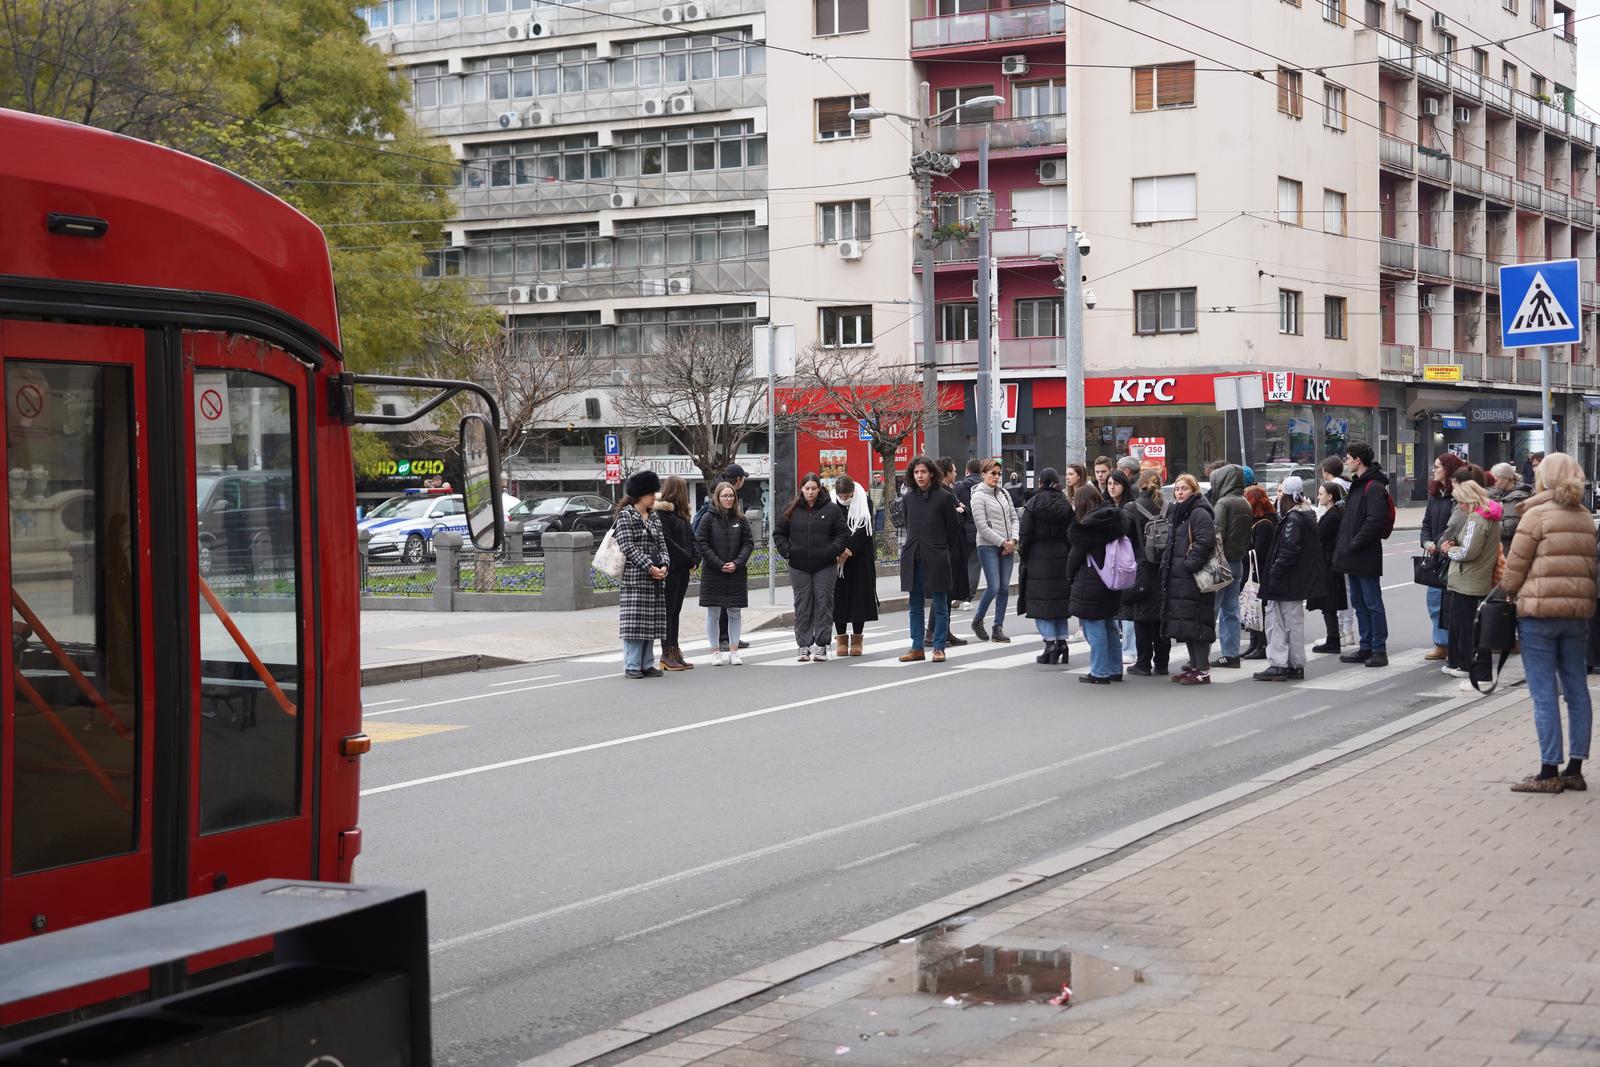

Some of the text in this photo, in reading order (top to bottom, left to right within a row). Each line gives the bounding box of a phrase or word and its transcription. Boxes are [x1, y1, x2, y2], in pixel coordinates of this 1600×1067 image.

[1110, 378, 1175, 402] KFC
[1305, 378, 1331, 402] KFC
[1473, 410, 1514, 422] ОДБРАНА
[608, 437, 616, 452] P
